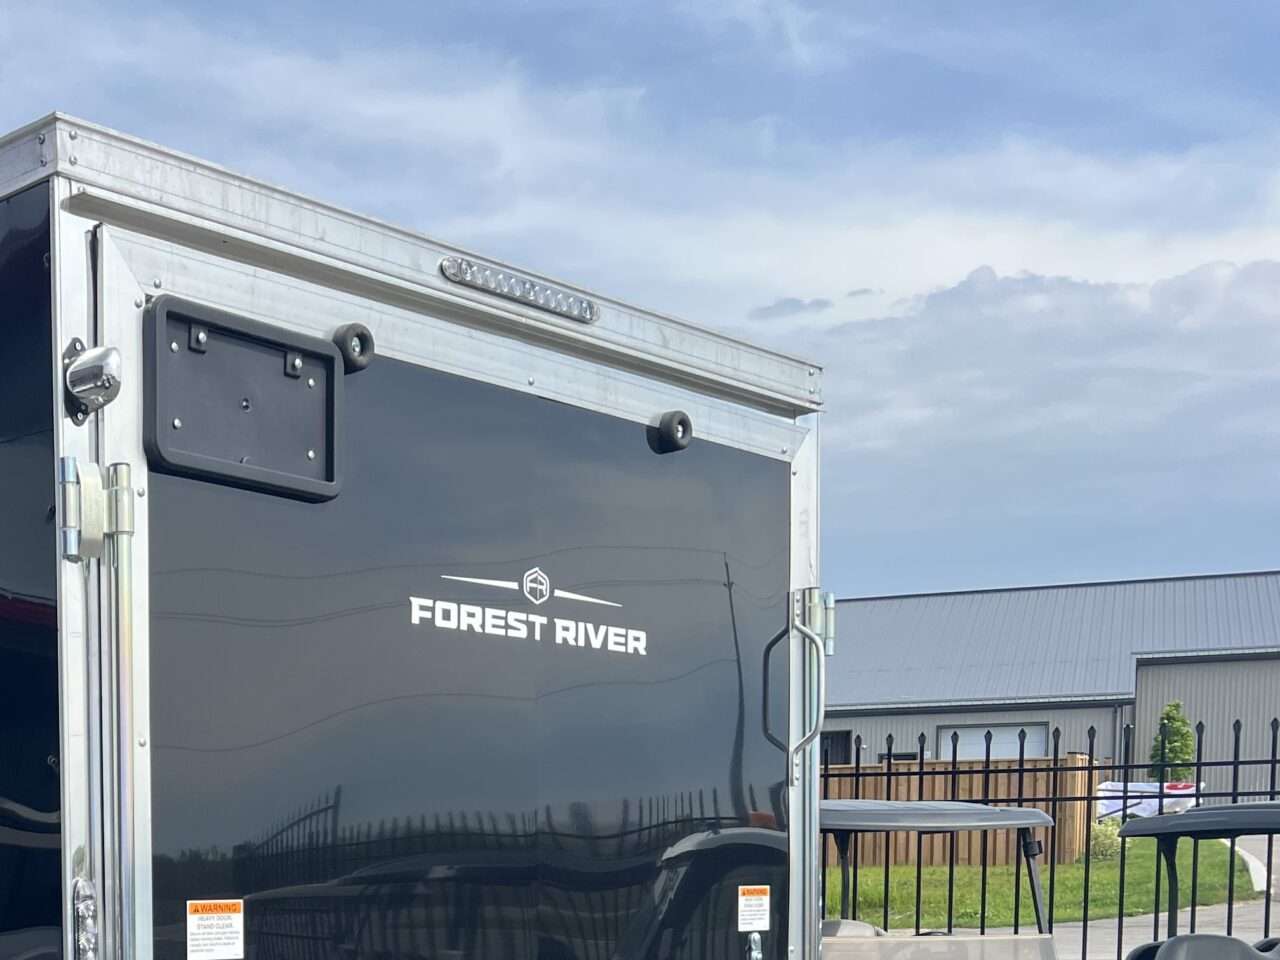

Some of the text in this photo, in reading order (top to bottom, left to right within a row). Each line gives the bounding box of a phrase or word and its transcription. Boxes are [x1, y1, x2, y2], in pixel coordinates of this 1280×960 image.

[409, 596, 647, 655] FOREST RIVER
[200, 903, 237, 913] WARNING
